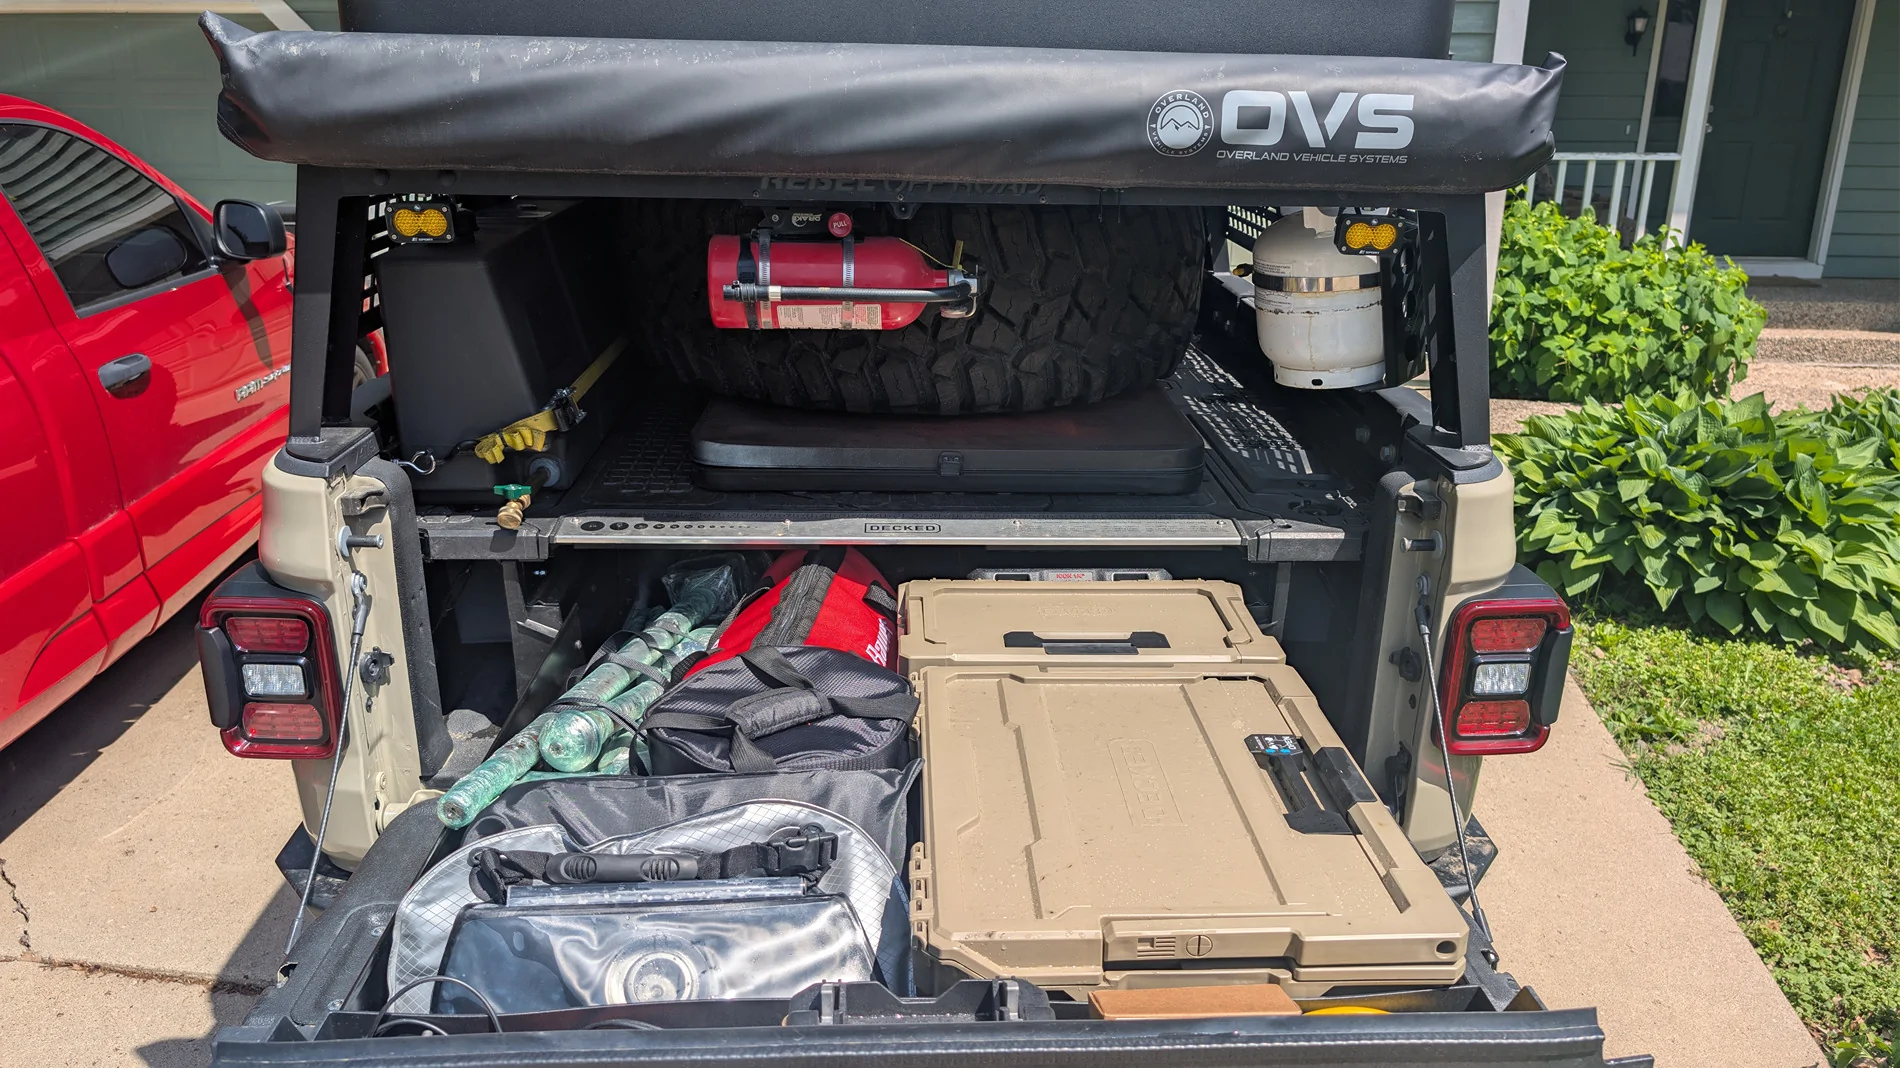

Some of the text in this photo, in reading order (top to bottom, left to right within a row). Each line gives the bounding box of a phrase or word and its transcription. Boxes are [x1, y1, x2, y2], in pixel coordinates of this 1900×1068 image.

[1155, 93, 1210, 119] OVERLAND
[1221, 89, 1415, 150] OVS
[1152, 131, 1209, 155] VEHICLE SYSTEMS
[1216, 150, 1408, 164] OVERLAND VEHICLE SYSTEMS
[832, 220, 848, 228] PULL
